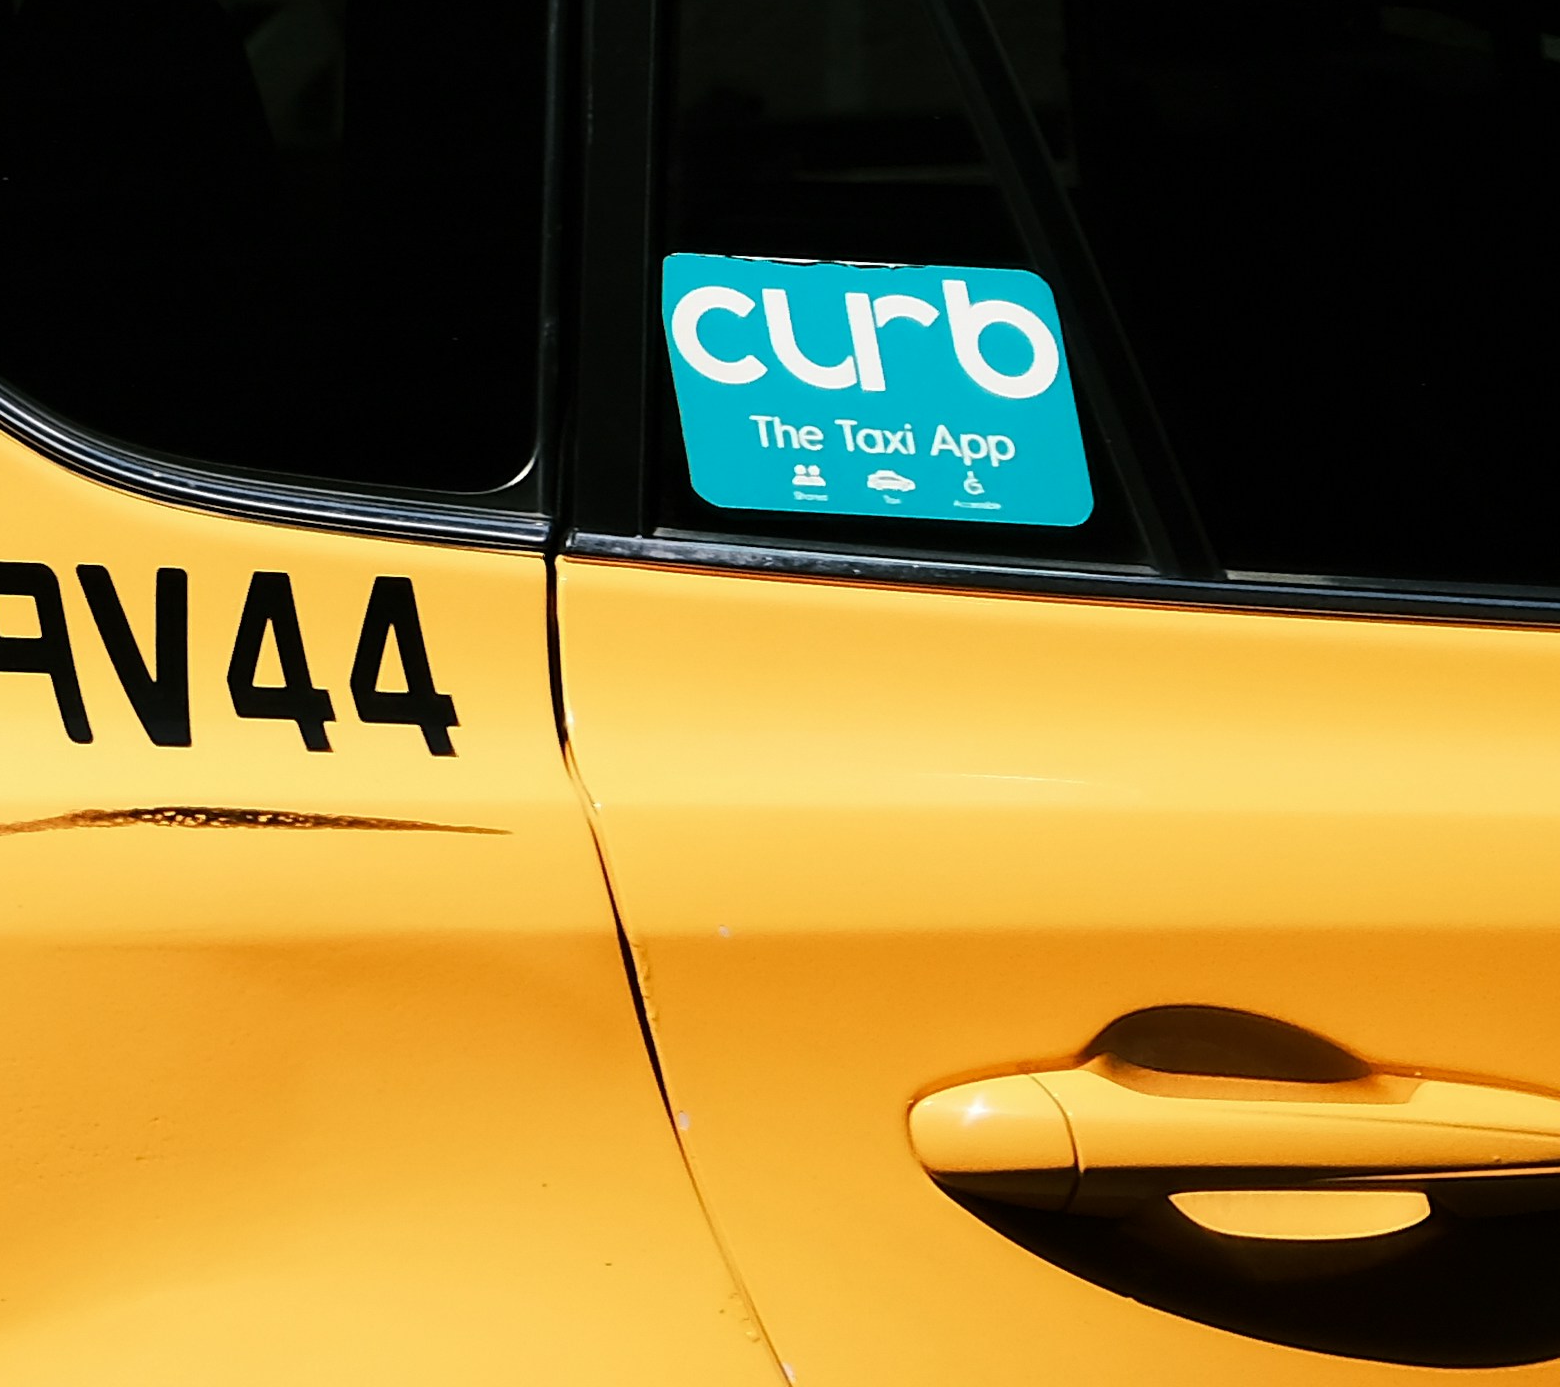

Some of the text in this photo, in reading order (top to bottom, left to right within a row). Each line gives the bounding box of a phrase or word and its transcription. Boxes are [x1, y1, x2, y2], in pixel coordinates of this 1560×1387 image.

[671, 279, 1060, 399] curb
[749, 415, 1016, 467] The Taxi App
